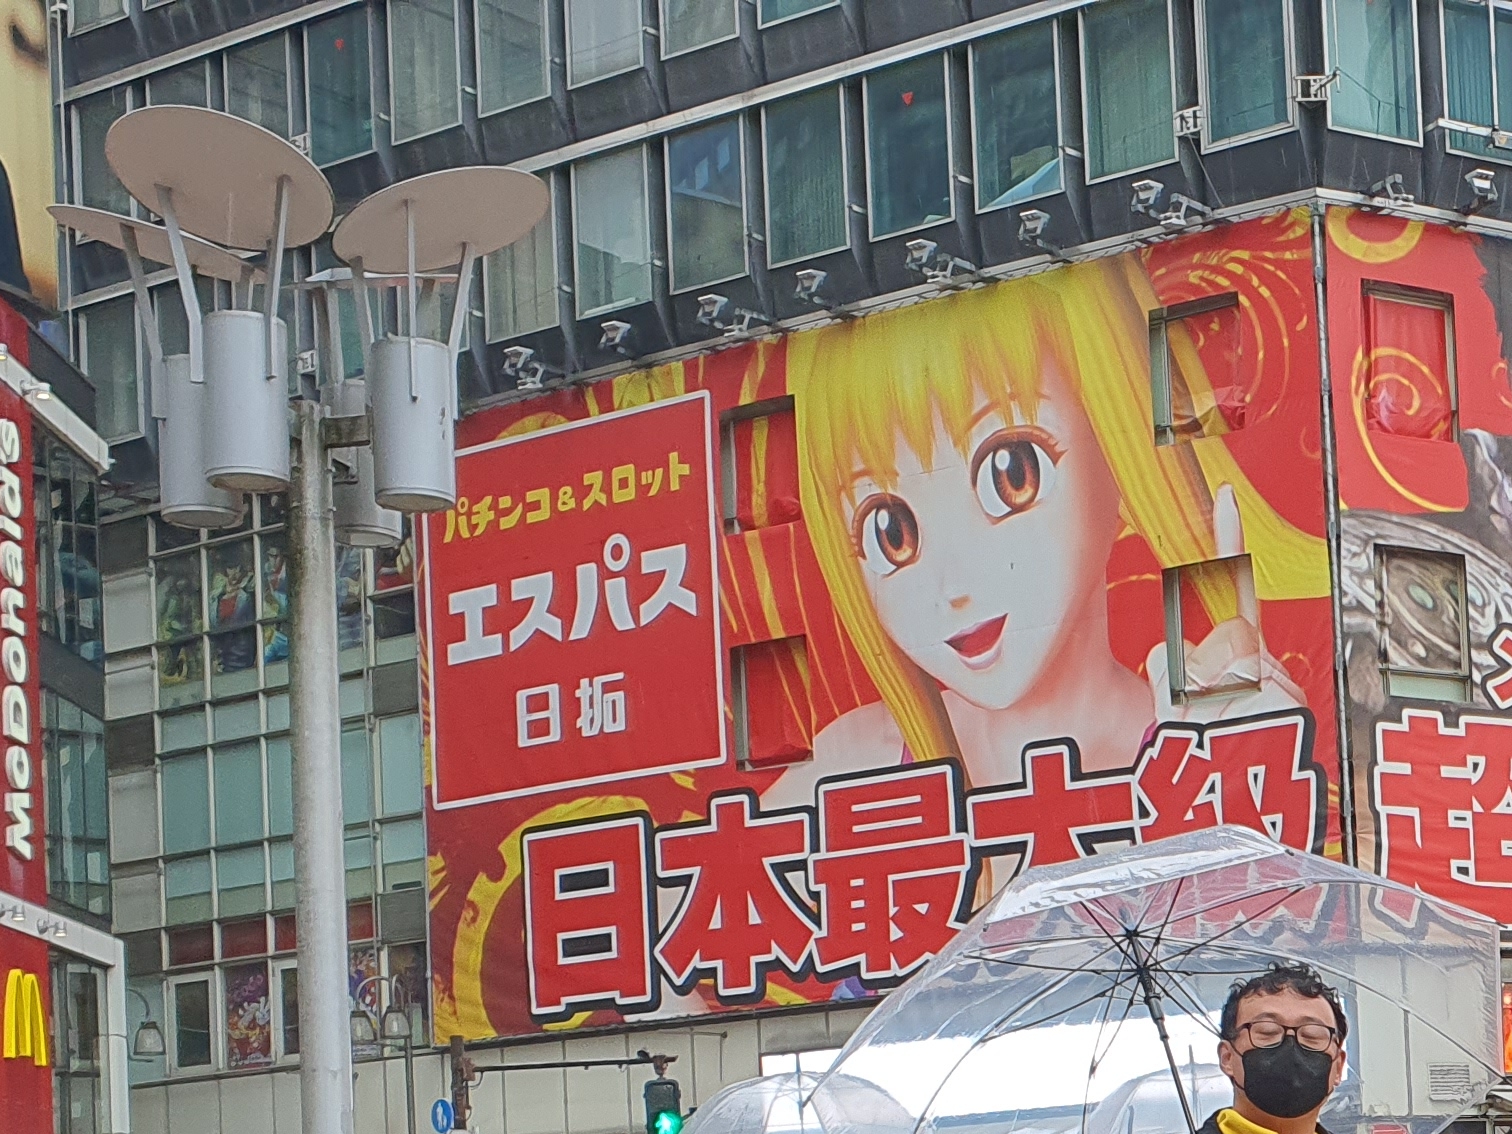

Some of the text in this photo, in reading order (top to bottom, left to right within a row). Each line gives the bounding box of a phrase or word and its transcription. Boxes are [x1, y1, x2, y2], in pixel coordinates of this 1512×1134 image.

[443, 452, 690, 543] パチンコ&スロット
[447, 533, 697, 666] エスパス
[521, 710, 1322, 1018] 日本最大級
